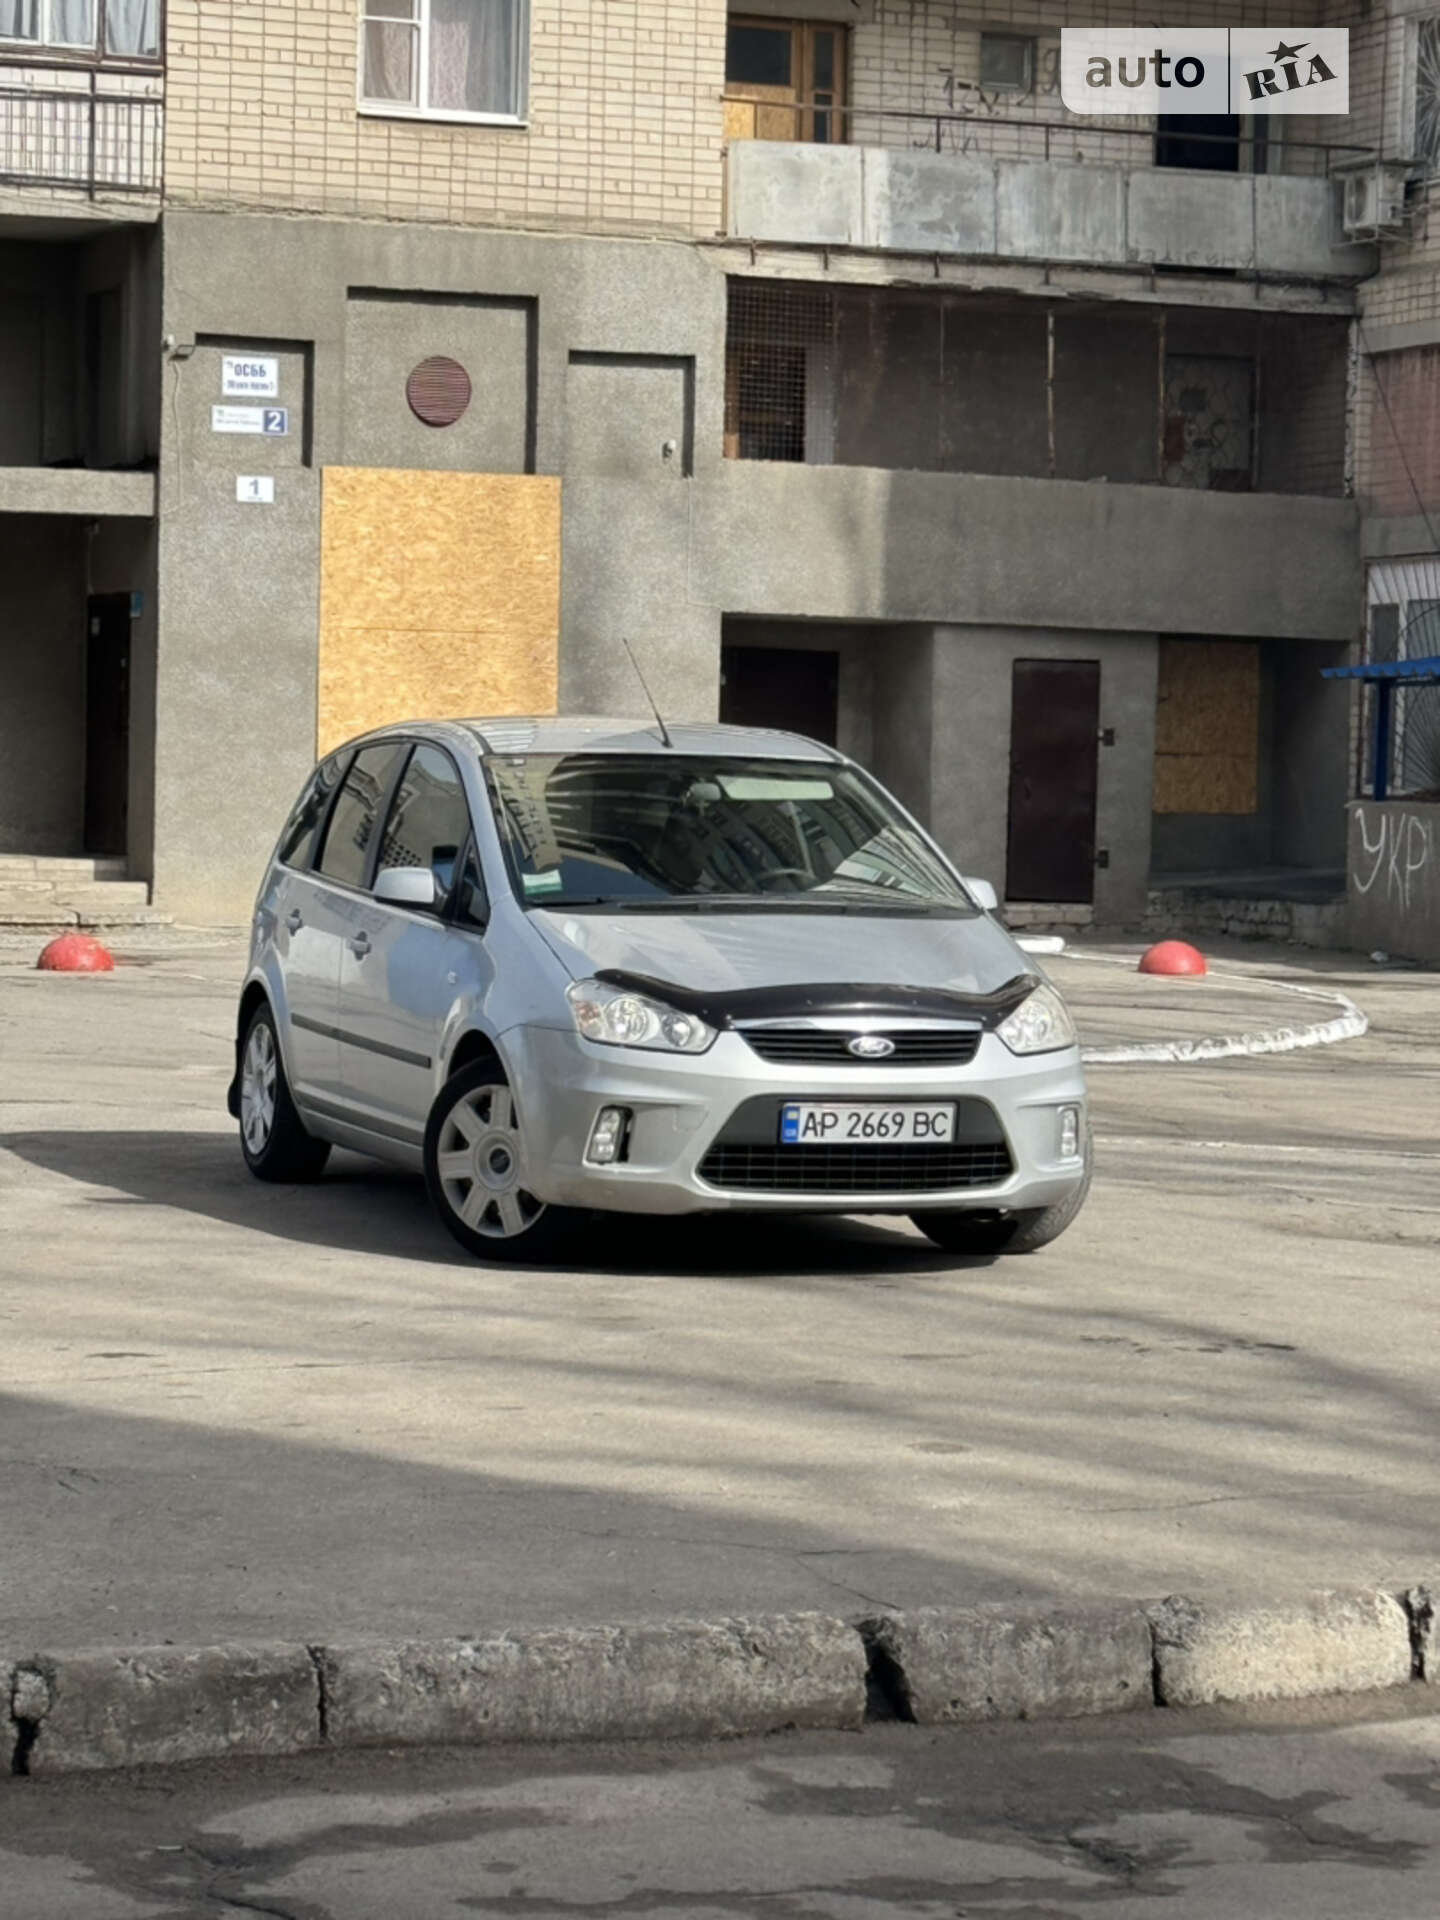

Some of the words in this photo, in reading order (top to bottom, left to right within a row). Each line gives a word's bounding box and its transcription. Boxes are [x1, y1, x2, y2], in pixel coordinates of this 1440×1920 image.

[267, 411, 281, 431] 2
[249, 479, 259, 495] 1
[801, 1111, 839, 1137] AP
[846, 1111, 906, 1137] 2669
[912, 1111, 949, 1137] BC
